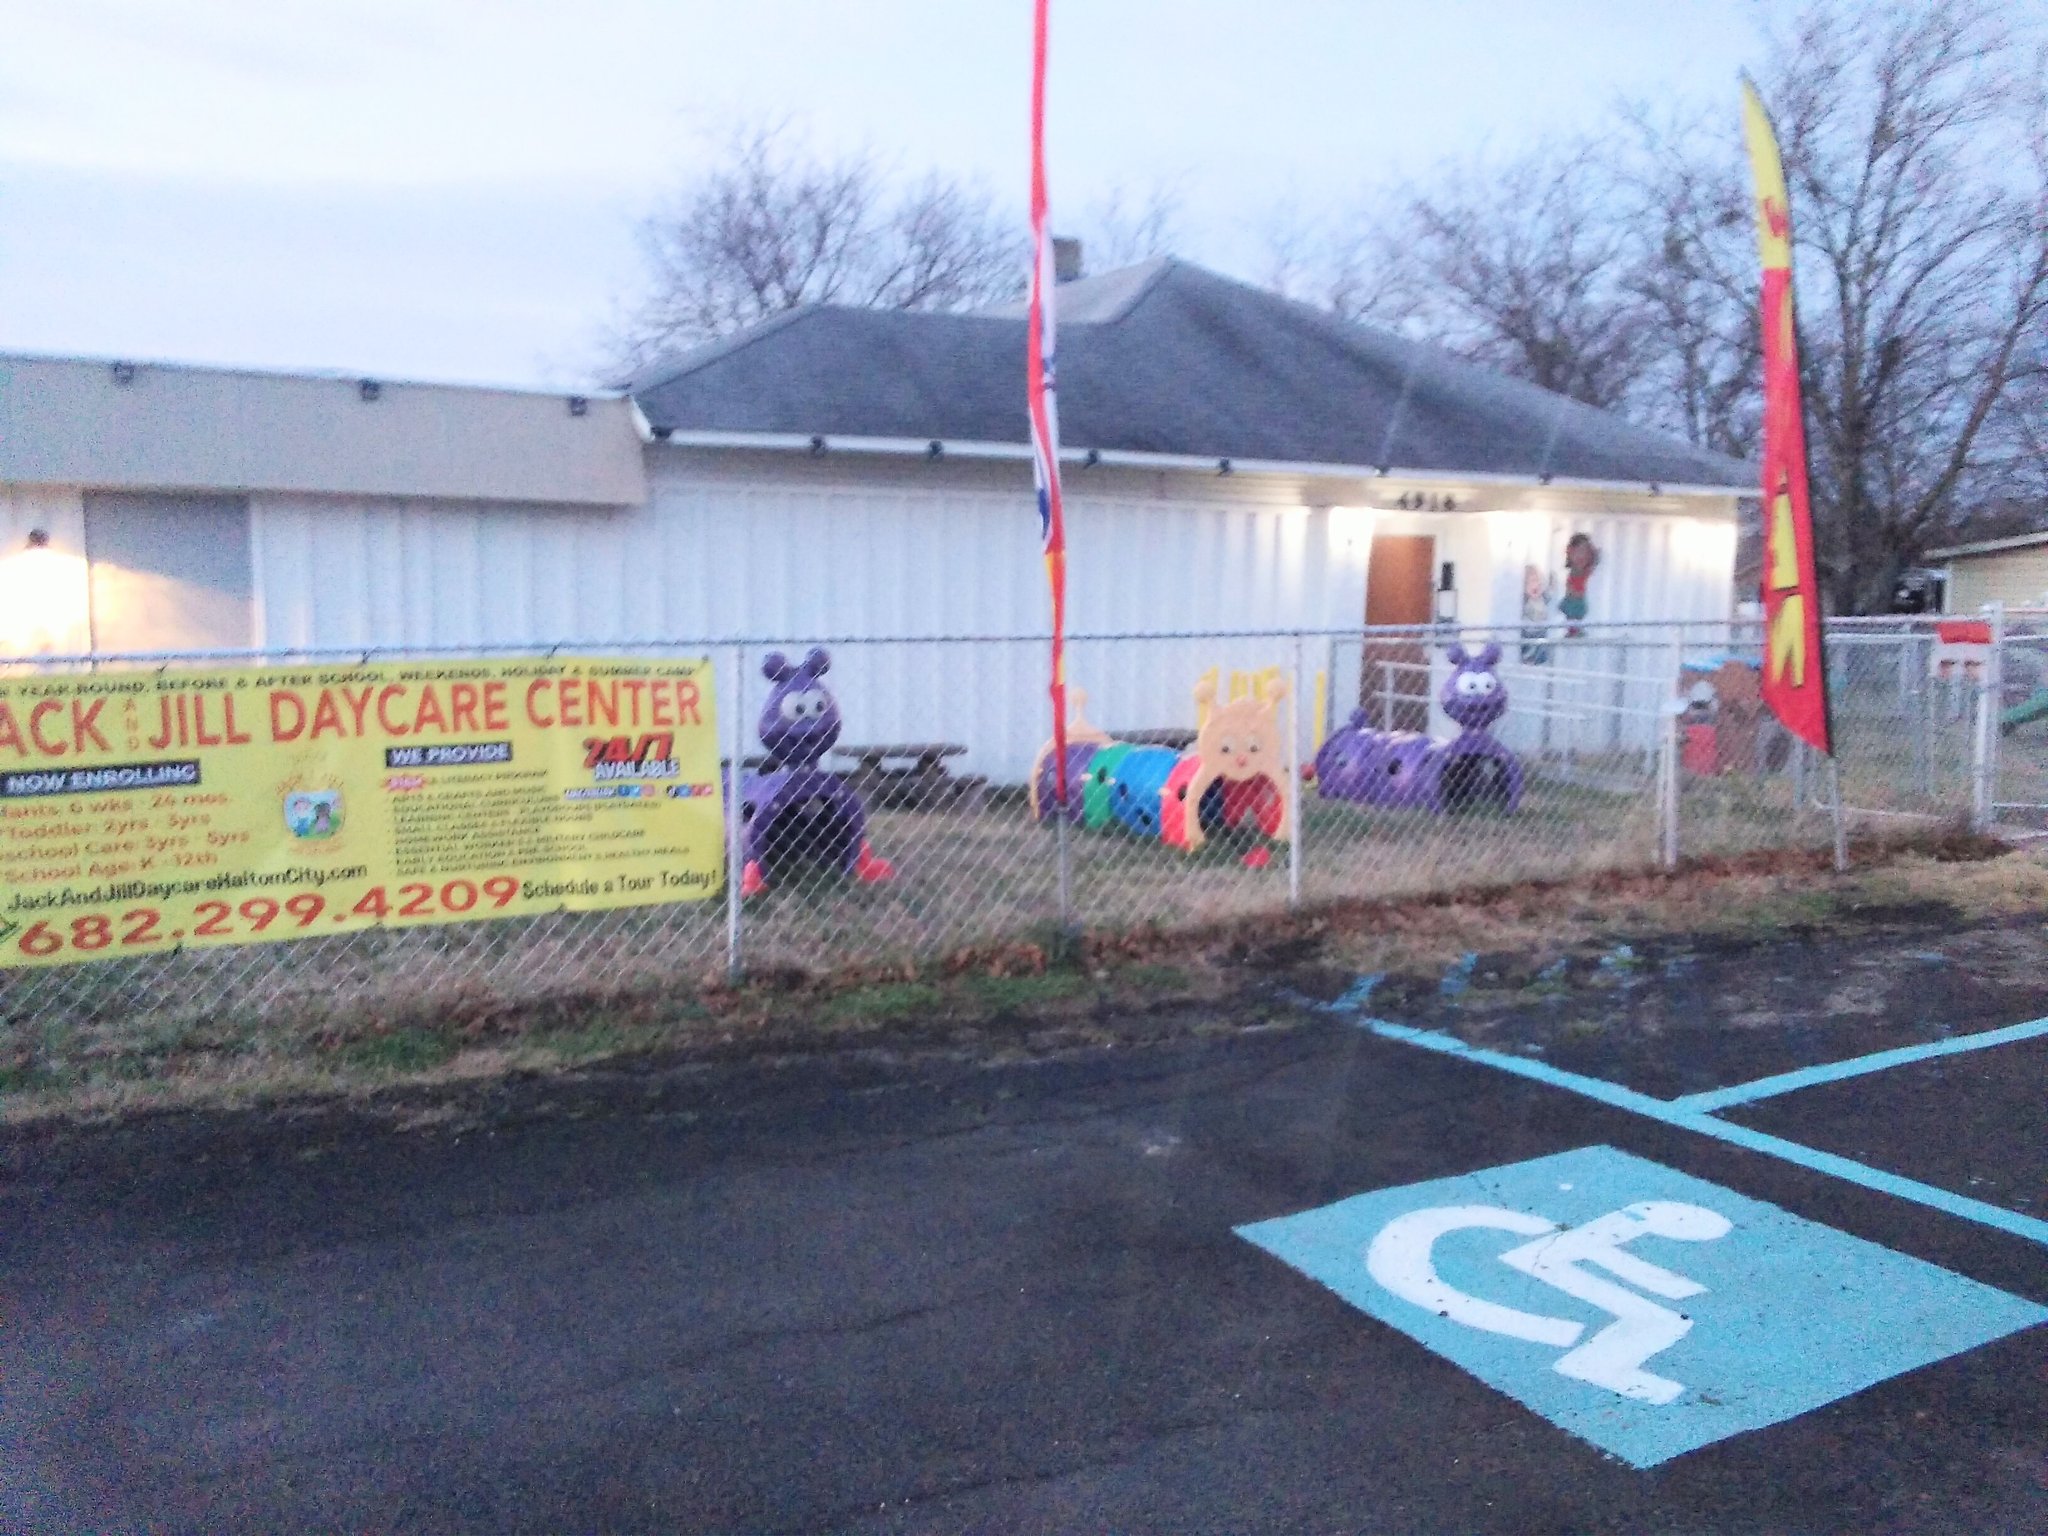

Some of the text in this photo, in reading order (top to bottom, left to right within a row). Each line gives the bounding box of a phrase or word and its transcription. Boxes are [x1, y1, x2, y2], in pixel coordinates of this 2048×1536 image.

[256, 674, 312, 687] AFTER
[148, 678, 704, 750] JILL DAYCARE CENTER
[392, 741, 508, 766] WE PROVIDE
[583, 731, 674, 769] 24/7
[6, 763, 197, 794] NOW ENROLLING
[594, 758, 681, 783] AVAILABLE
[523, 868, 718, 899] Schedule a Tour Today!
[18, 875, 520, 958] 682.299.4209
